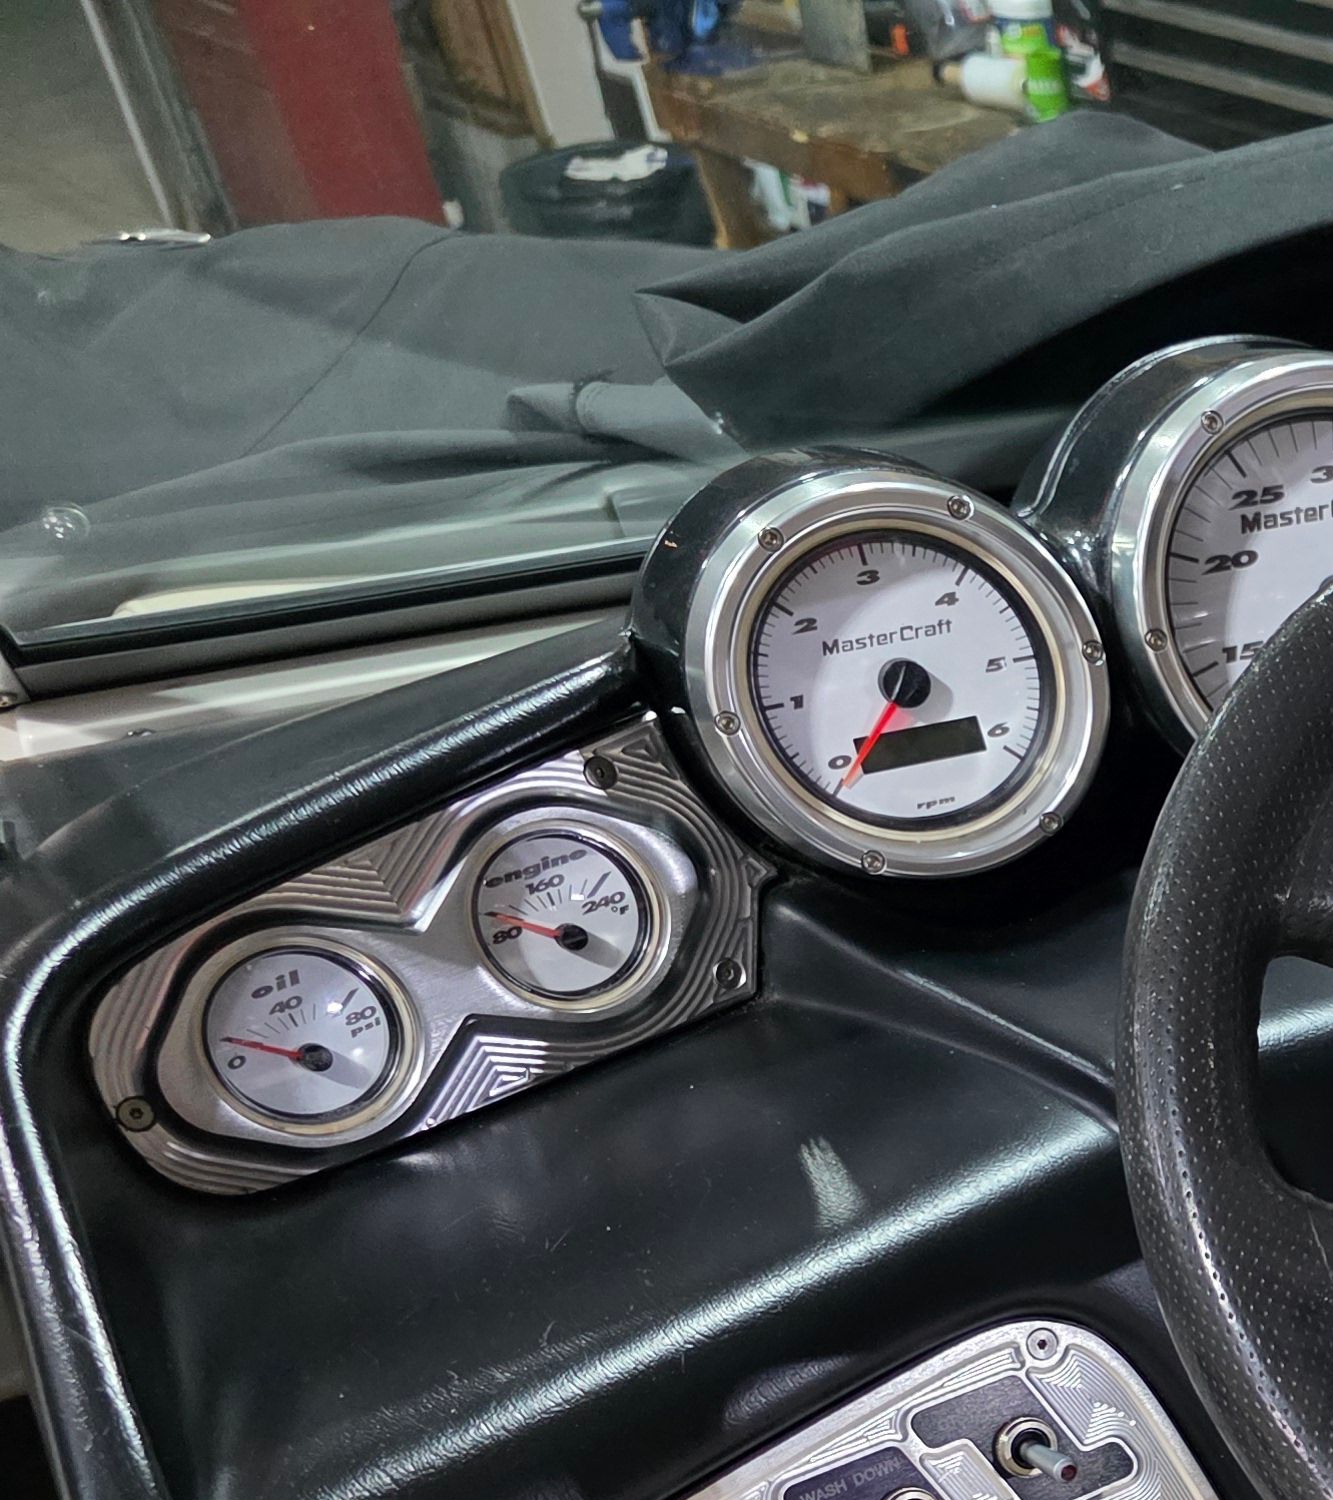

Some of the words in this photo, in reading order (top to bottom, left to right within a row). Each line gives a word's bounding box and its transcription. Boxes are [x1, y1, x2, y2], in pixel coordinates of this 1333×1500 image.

[1227, 485, 1285, 511] 25
[1202, 550, 1259, 575] 20
[856, 570, 880, 586] 3
[934, 591, 959, 607] 4
[792, 618, 818, 635] 2
[822, 618, 953, 657] MasterCraft
[985, 657, 1007, 674] 5
[789, 694, 805, 710] 1
[986, 723, 1010, 738] 6
[827, 754, 852, 770] 0
[916, 795, 956, 810] rpm
[485, 849, 588, 888] engine
[525, 874, 565, 895] 160
[582, 891, 626, 916] 240
[492, 926, 523, 945] 80
[251, 969, 300, 999] oil
[269, 995, 303, 1016] 40
[345, 1005, 377, 1026] 80
[351, 1017, 382, 1038] psi
[227, 1055, 246, 1070] 0
[851, 1458, 902, 1488] DOWN
